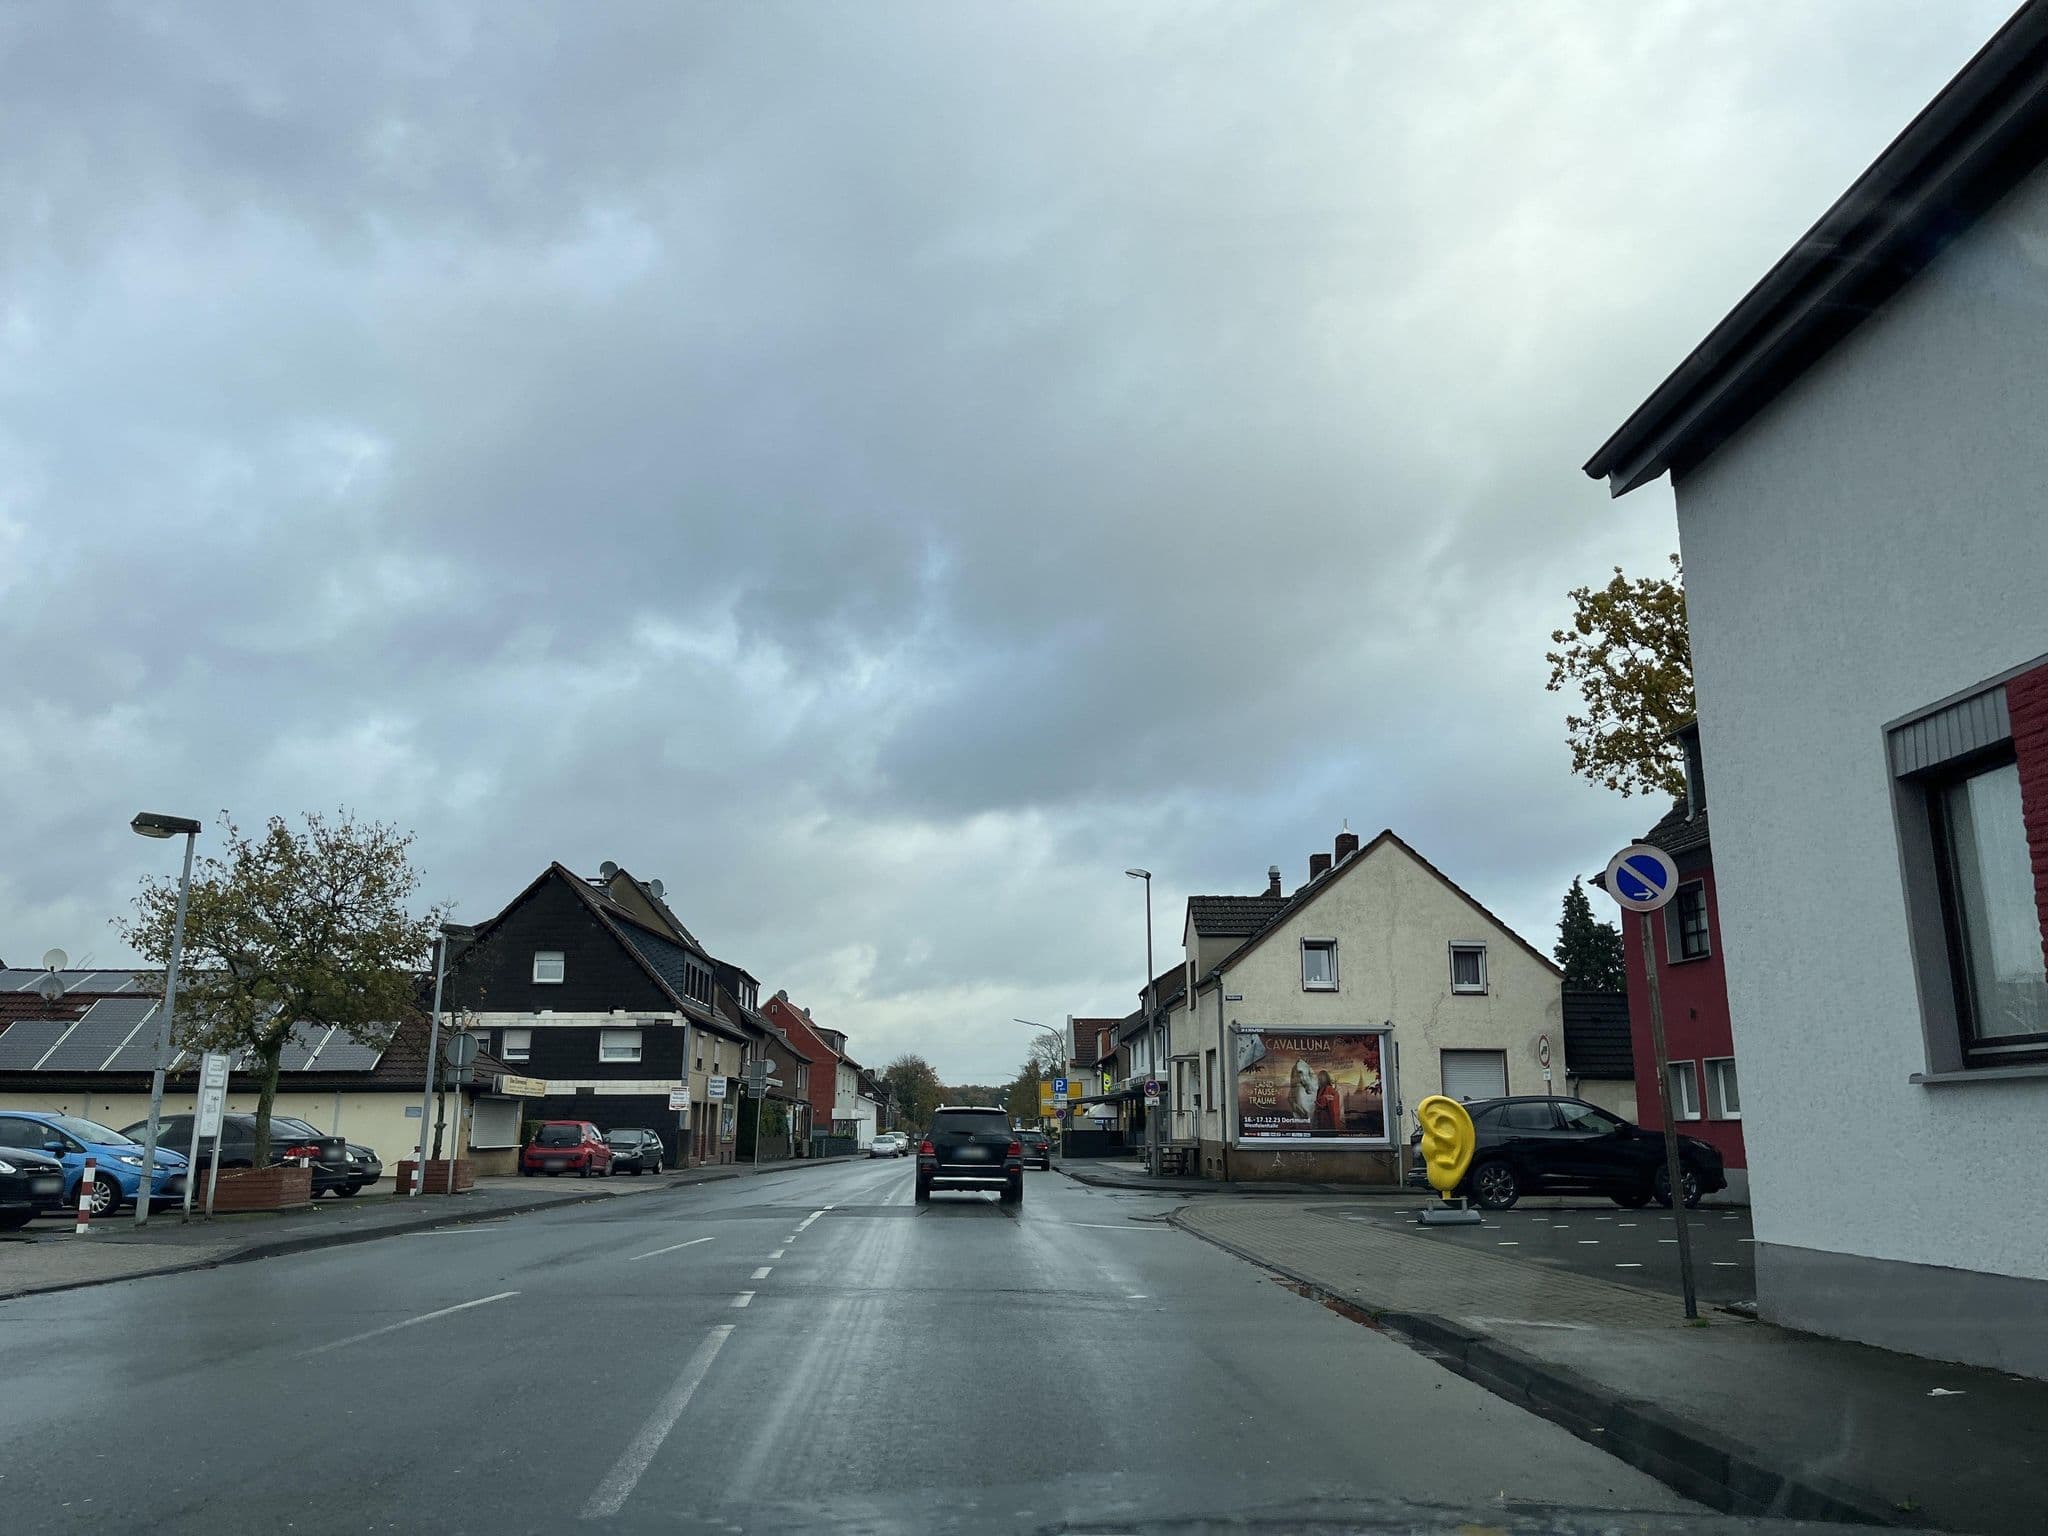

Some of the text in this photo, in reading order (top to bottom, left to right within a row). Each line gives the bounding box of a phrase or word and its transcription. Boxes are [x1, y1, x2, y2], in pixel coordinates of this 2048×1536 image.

[1264, 1038, 1331, 1051] CAVALLUNA
[1055, 1080, 1064, 1091] P
[1281, 1116, 1311, 1124] Dortmund
